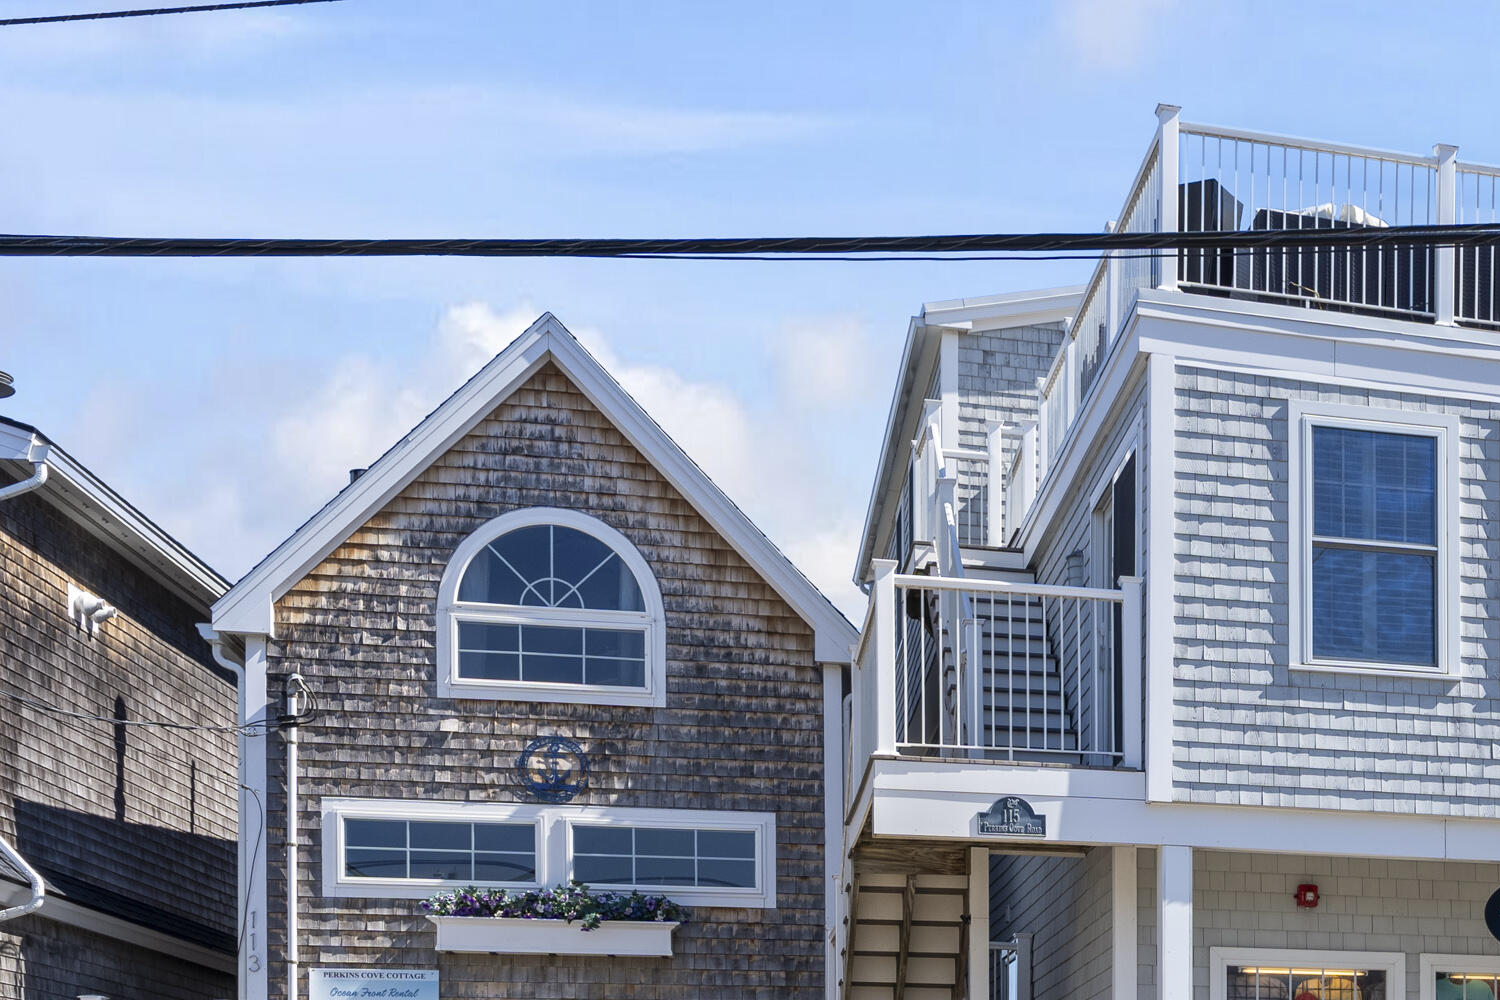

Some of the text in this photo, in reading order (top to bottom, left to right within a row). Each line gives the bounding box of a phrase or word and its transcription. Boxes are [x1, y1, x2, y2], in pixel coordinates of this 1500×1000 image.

[1003, 808, 1020, 823] 115
[248, 910, 260, 973] 113
[323, 971, 360, 979] PERKINS
[386, 972, 426, 980] COTTAGE
[329, 986, 420, 998] Ocean Front Rental
